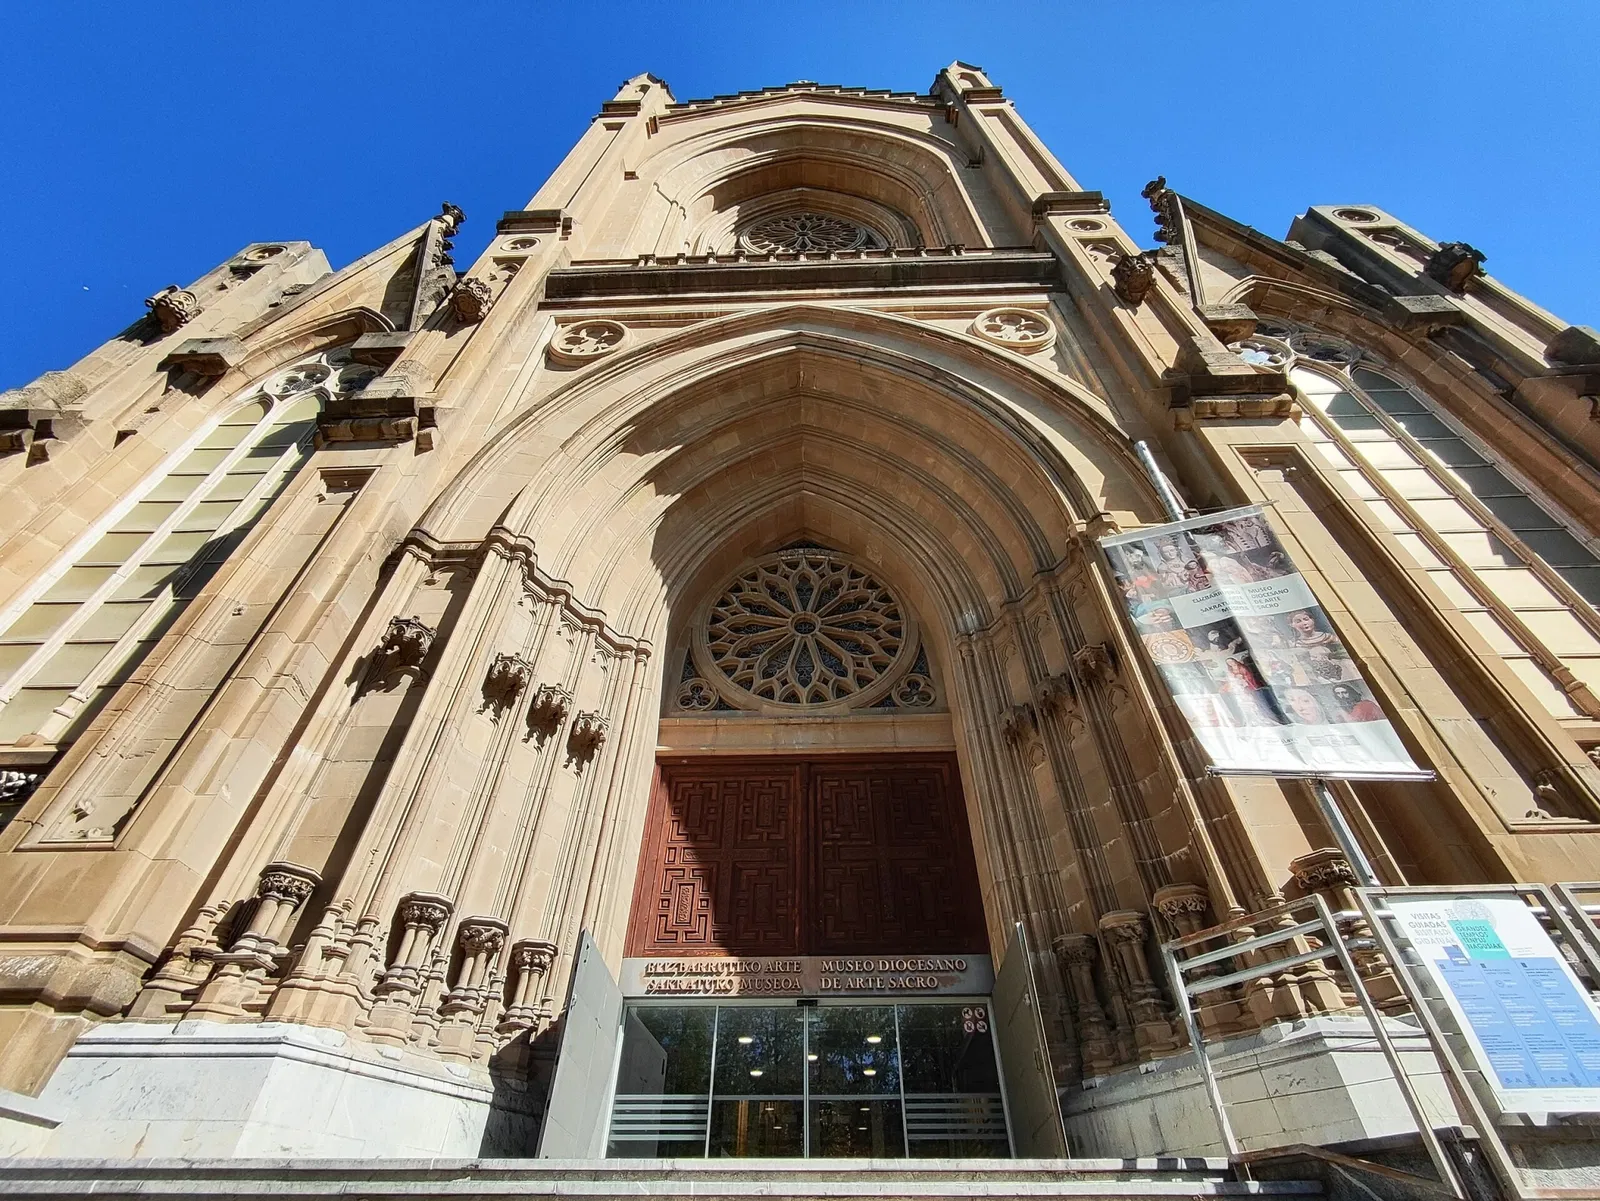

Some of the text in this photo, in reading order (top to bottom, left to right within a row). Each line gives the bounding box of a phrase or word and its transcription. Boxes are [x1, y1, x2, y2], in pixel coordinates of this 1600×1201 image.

[1248, 585, 1273, 594] MUSEO
[1251, 588, 1290, 599] DIOCESANO
[1264, 596, 1282, 604] ARTE
[1410, 912, 1442, 920] VISITAS
[1408, 921, 1447, 929] GUIADAS
[645, 959, 802, 975] ELIZBARRUTIKO ARTE
[820, 958, 968, 973] MUSEO DIOCESANO
[647, 977, 802, 992] SAKRATUKO MUSEOA
[820, 975, 939, 989] DE ARTE SACRO
